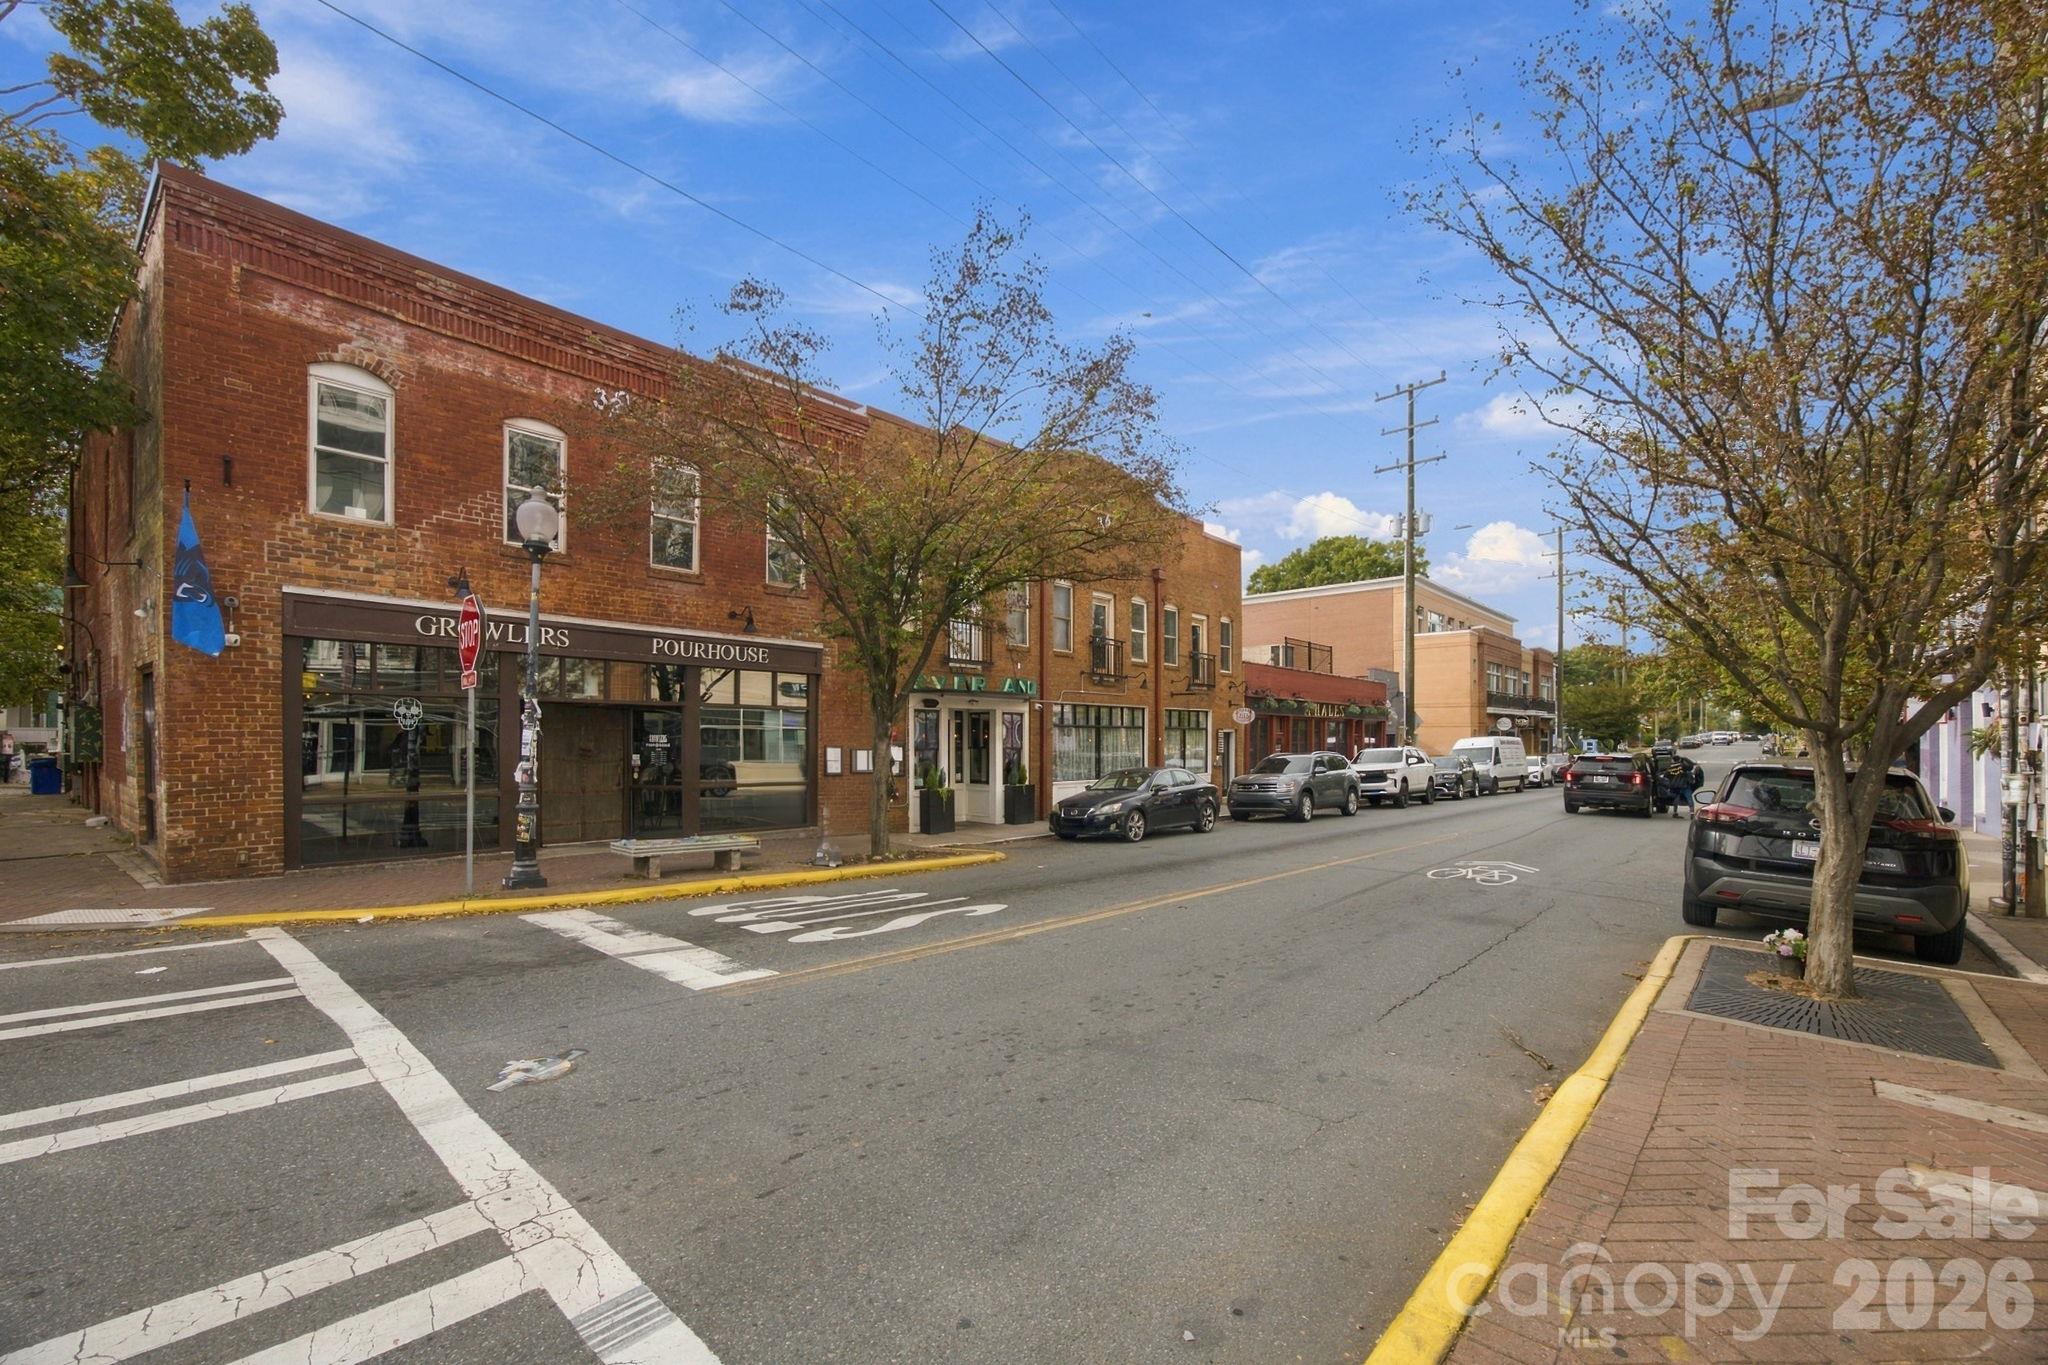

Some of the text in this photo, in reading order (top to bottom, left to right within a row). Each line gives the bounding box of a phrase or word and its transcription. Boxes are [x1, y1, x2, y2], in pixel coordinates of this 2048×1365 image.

[415, 615, 570, 648] GRWLRS
[460, 619, 479, 650] STOP
[652, 638, 769, 664] POURHOUSE
